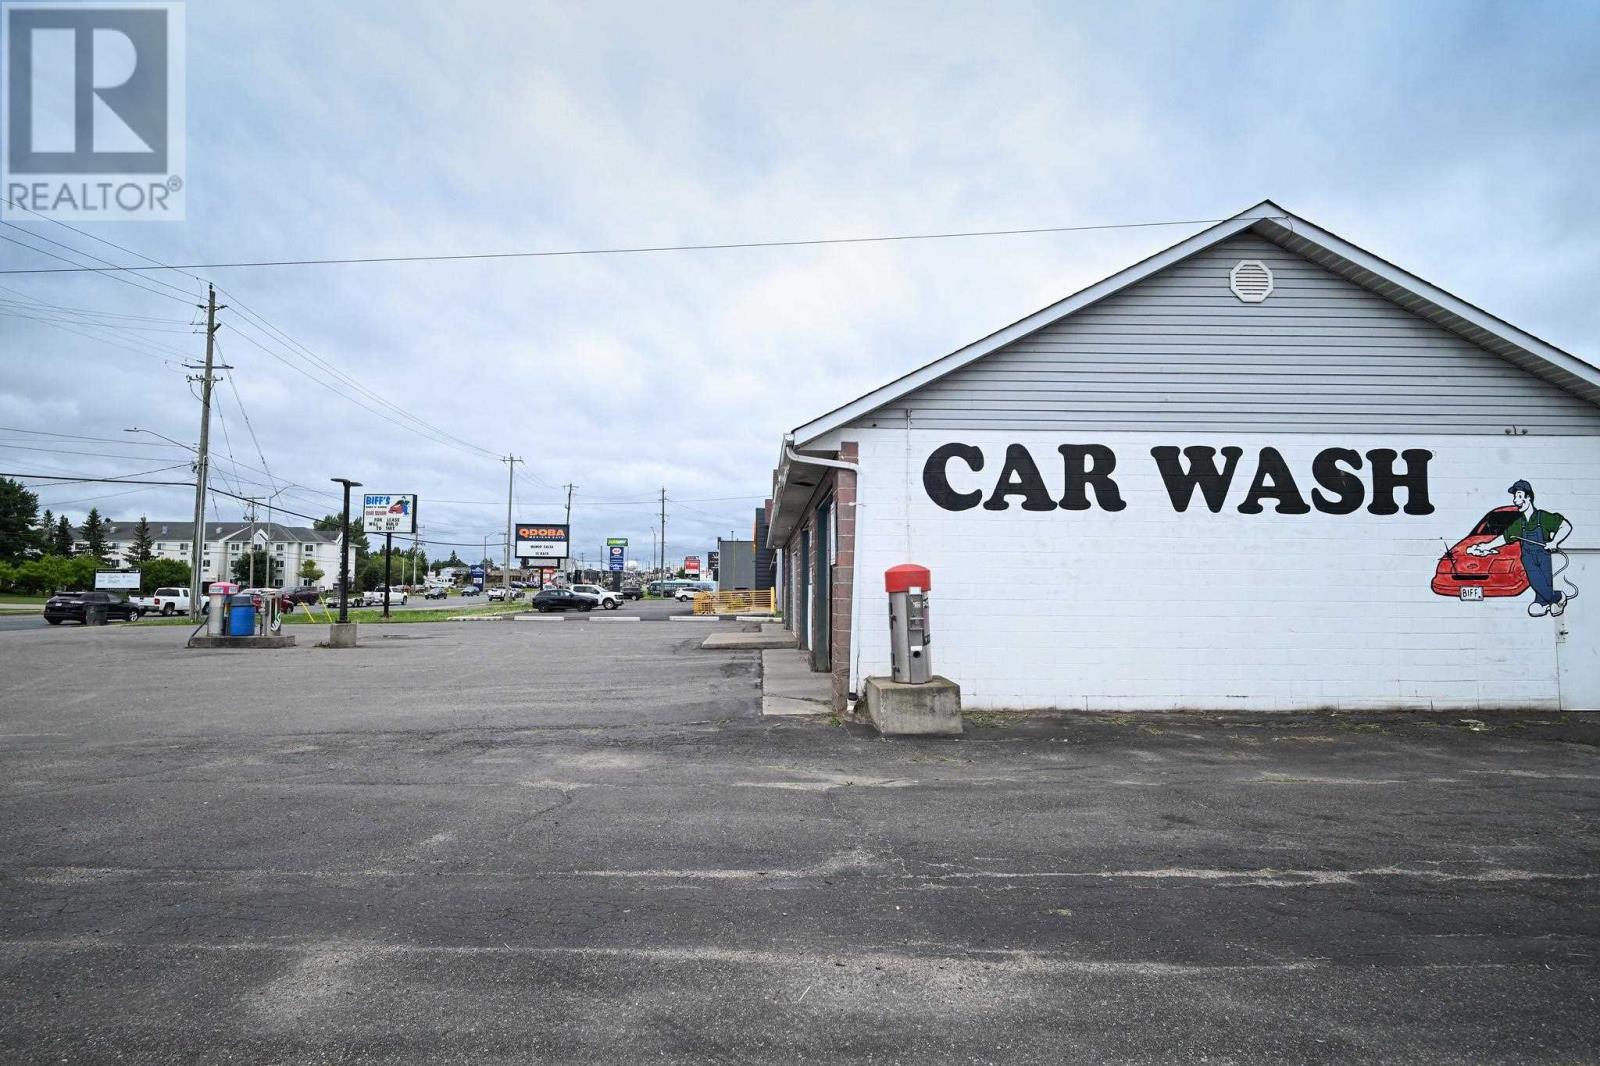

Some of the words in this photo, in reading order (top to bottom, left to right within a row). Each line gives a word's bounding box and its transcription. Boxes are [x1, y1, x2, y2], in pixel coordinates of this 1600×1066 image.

[922, 442, 1127, 512] CAR
[1150, 445, 1436, 515] WASH
[366, 496, 391, 505] BIFF'S
[519, 528, 566, 538] QDOBA
